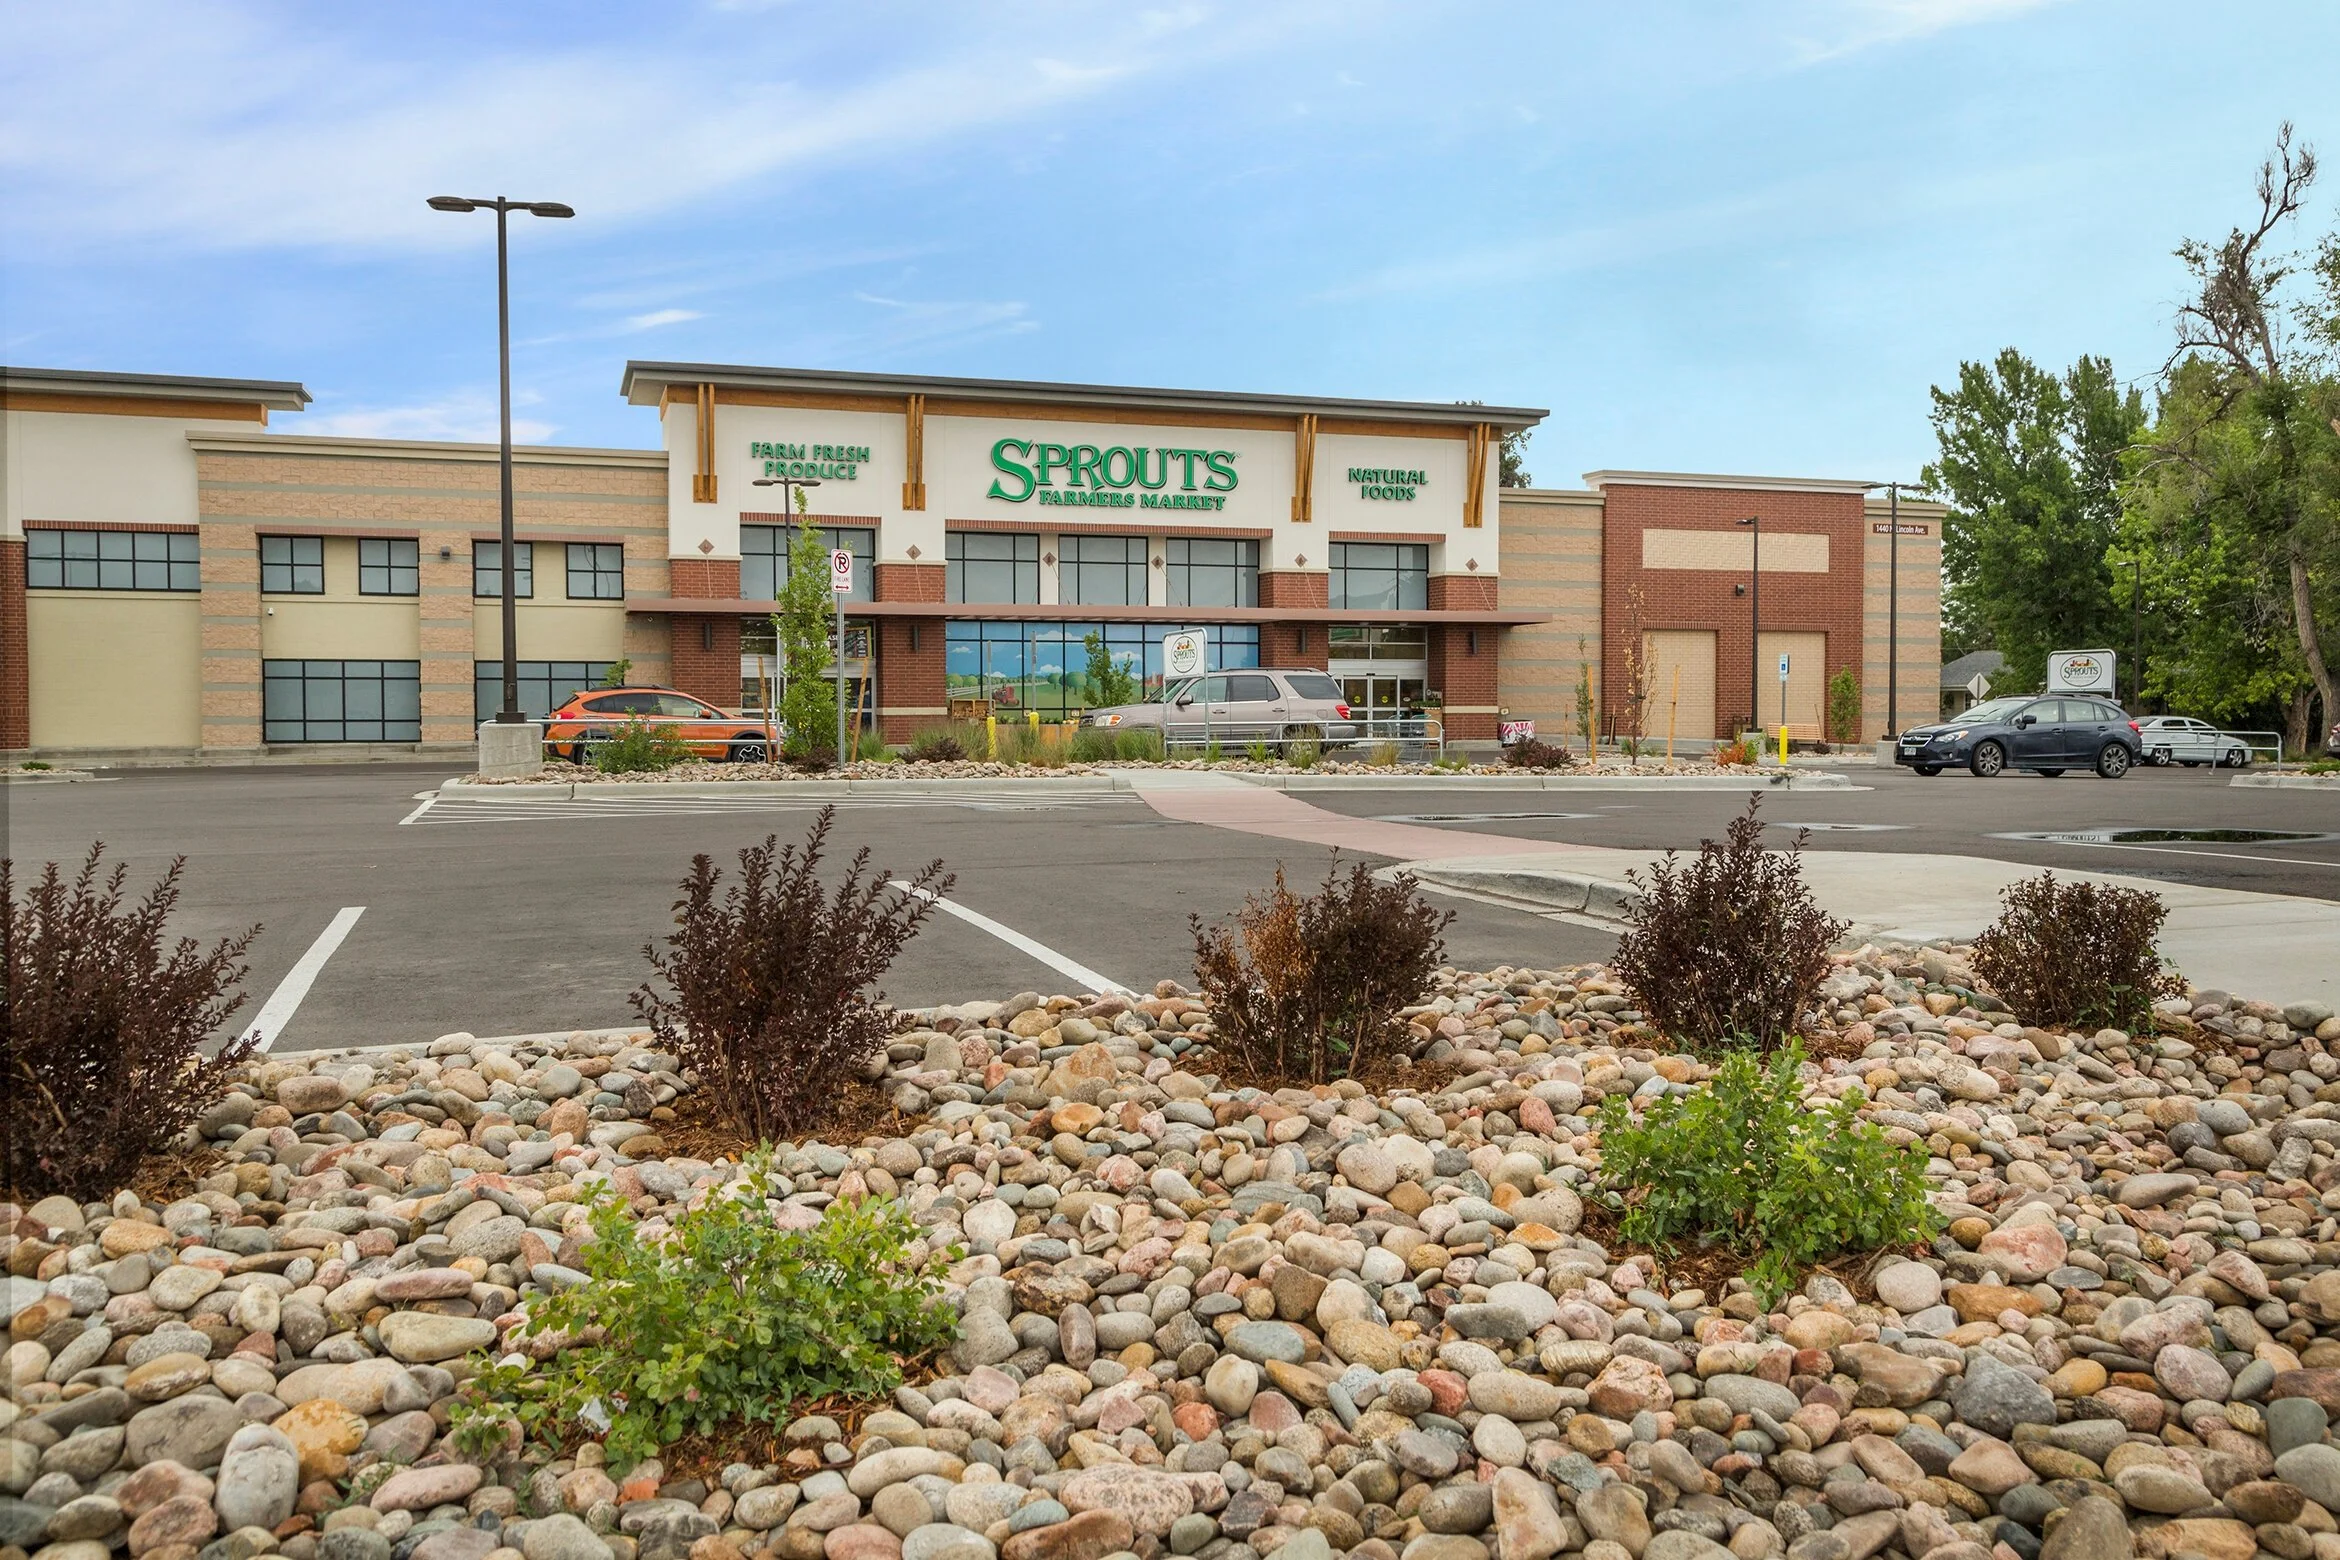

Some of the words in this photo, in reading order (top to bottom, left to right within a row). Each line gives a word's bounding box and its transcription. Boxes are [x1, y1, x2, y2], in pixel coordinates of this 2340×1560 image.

[751, 442, 806, 460] FARM
[813, 444, 870, 463] FRESH
[764, 461, 857, 480] PRODUCE
[987, 438, 1238, 502] SPROUTS
[1348, 468, 1429, 485] NATURAL
[1039, 489, 1135, 508] FARMERS
[1140, 493, 1226, 511] MARKET
[1361, 485, 1416, 501] FOODS
[1876, 524, 1889, 533] 1440
[1896, 525, 1914, 534] Lincoln
[2063, 666, 2099, 679] SPROUTS
